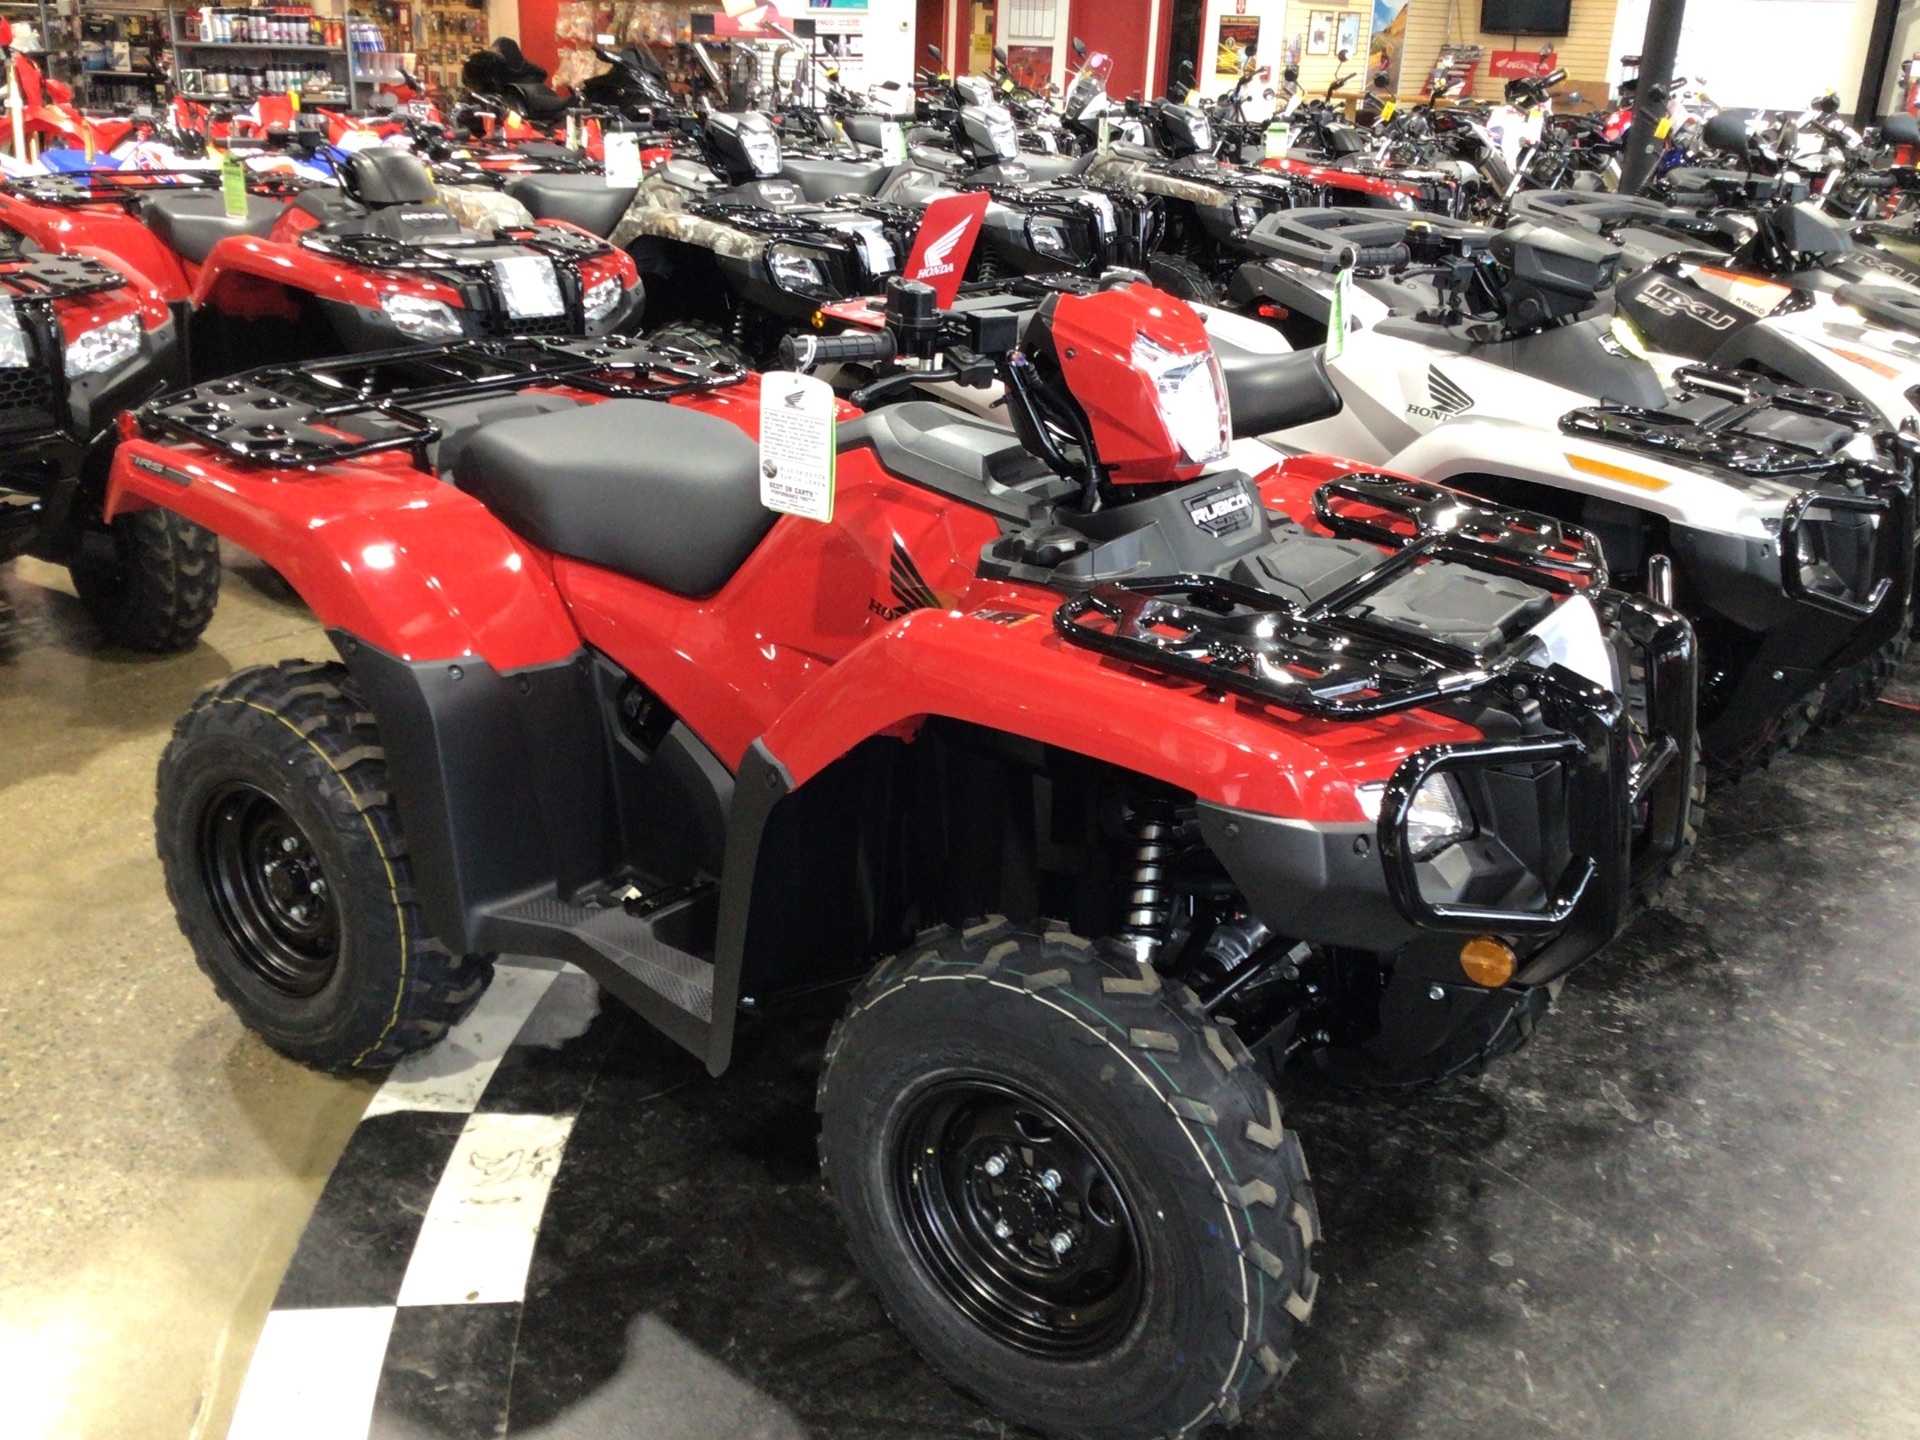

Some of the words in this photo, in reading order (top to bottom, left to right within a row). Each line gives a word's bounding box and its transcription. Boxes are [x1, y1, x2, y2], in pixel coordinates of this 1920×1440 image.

[916, 262, 955, 280] HONDA
[1643, 281, 1737, 331] MXU
[1735, 296, 1766, 316] KYMCO
[1190, 492, 1253, 526] RUBICON
